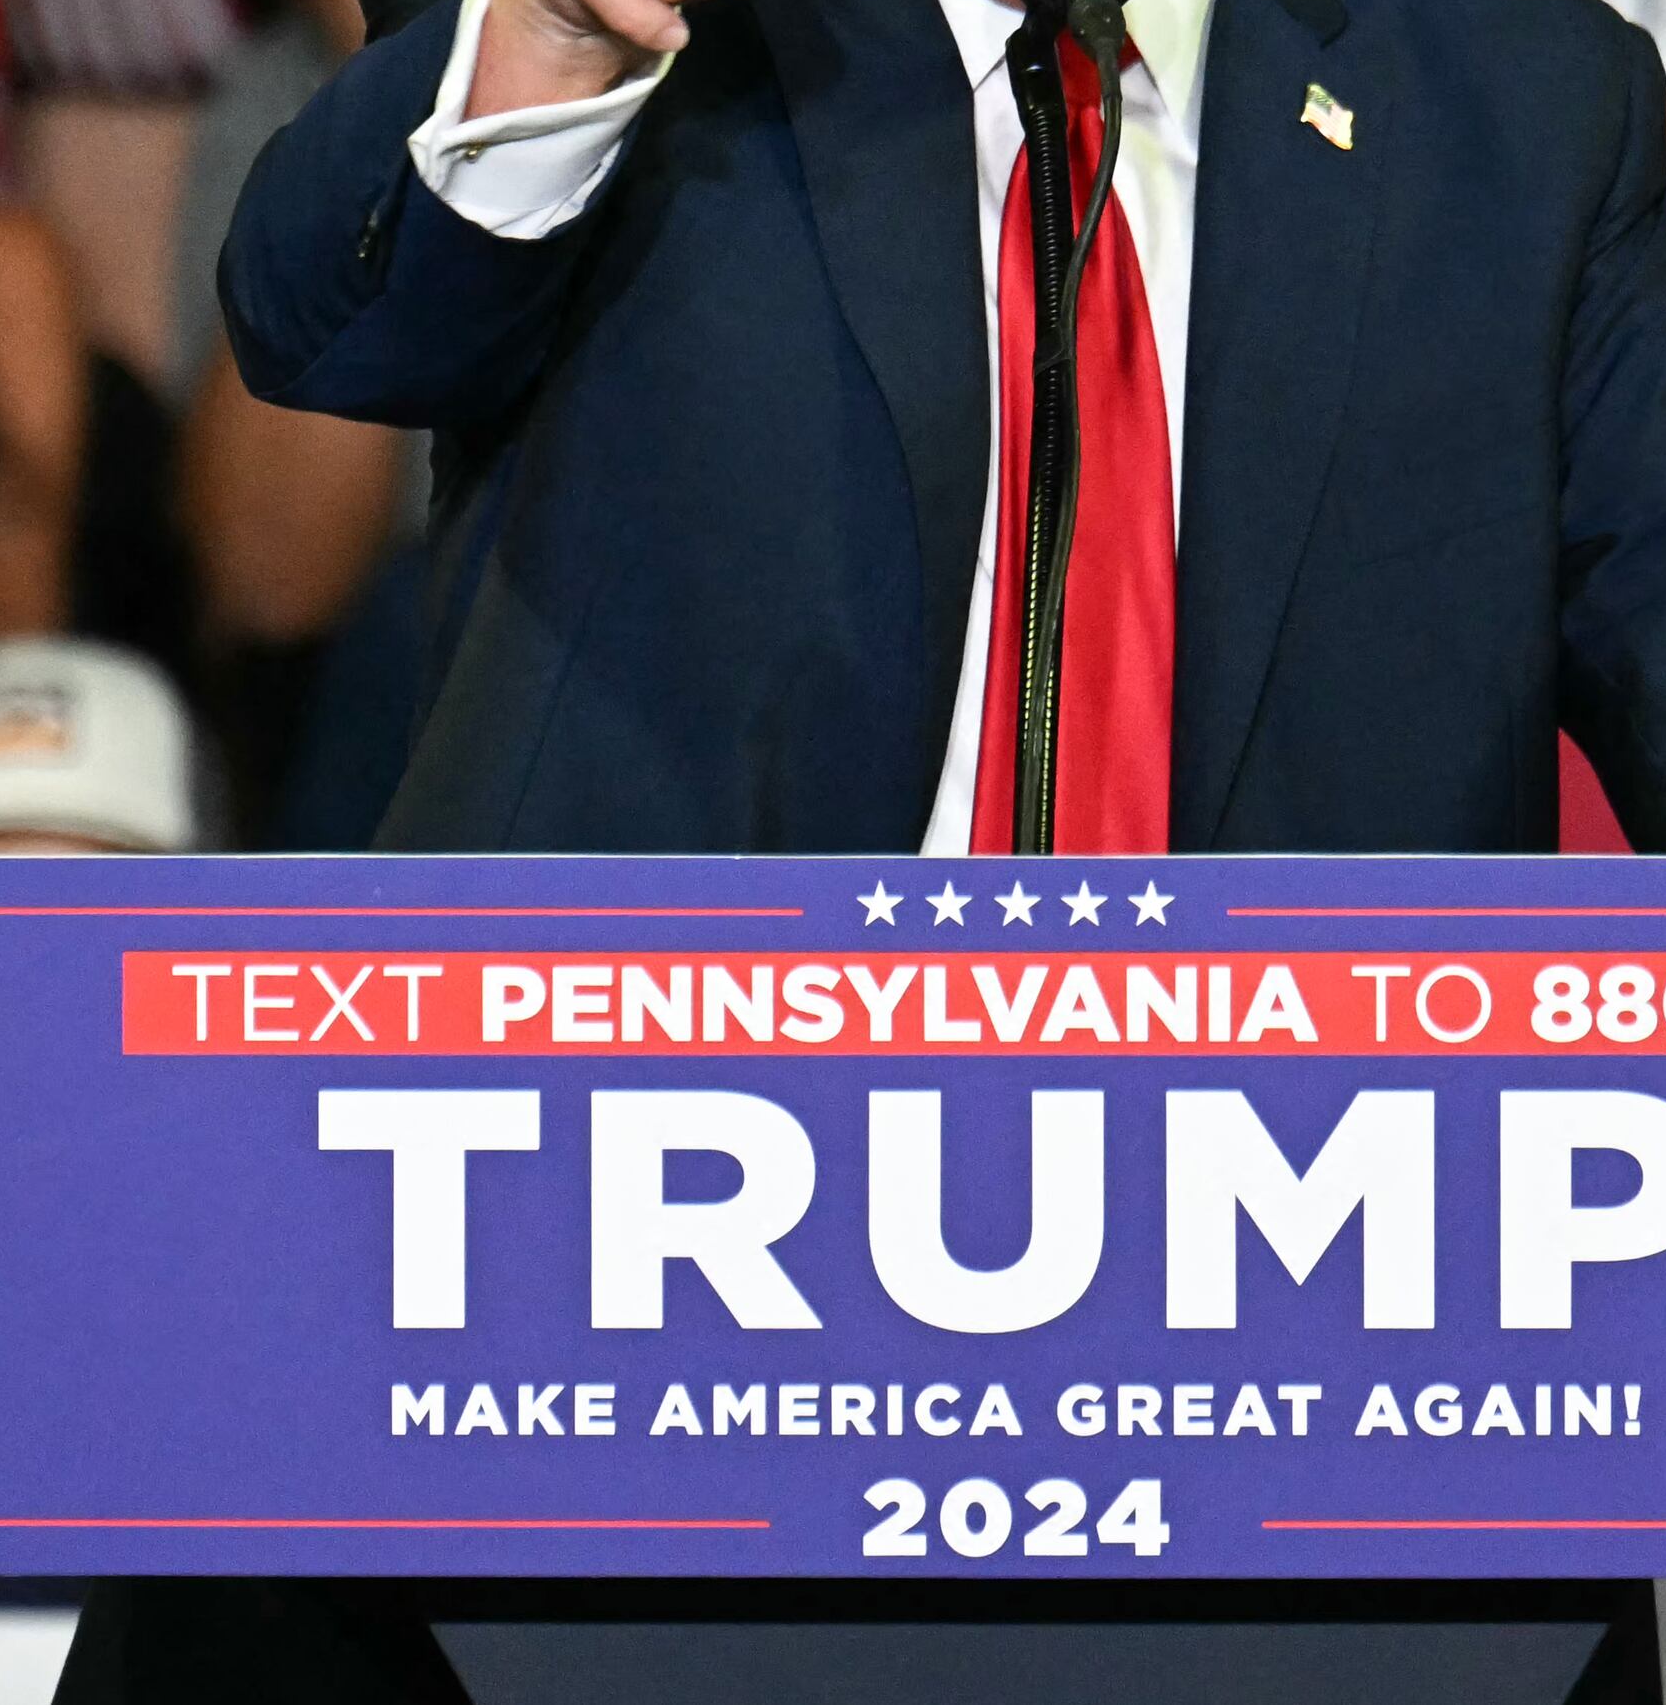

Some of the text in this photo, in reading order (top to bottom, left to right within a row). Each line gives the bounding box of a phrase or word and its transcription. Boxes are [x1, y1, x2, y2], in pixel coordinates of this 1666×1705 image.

[172, 965, 443, 1043] TEXT
[481, 965, 1319, 1043] PENNSYLVANIA
[1351, 965, 1492, 1044] TO
[390, 1383, 1642, 1437] MAKE AMERICA GREAT AGAIN!
[862, 1477, 1171, 1558] 2024
